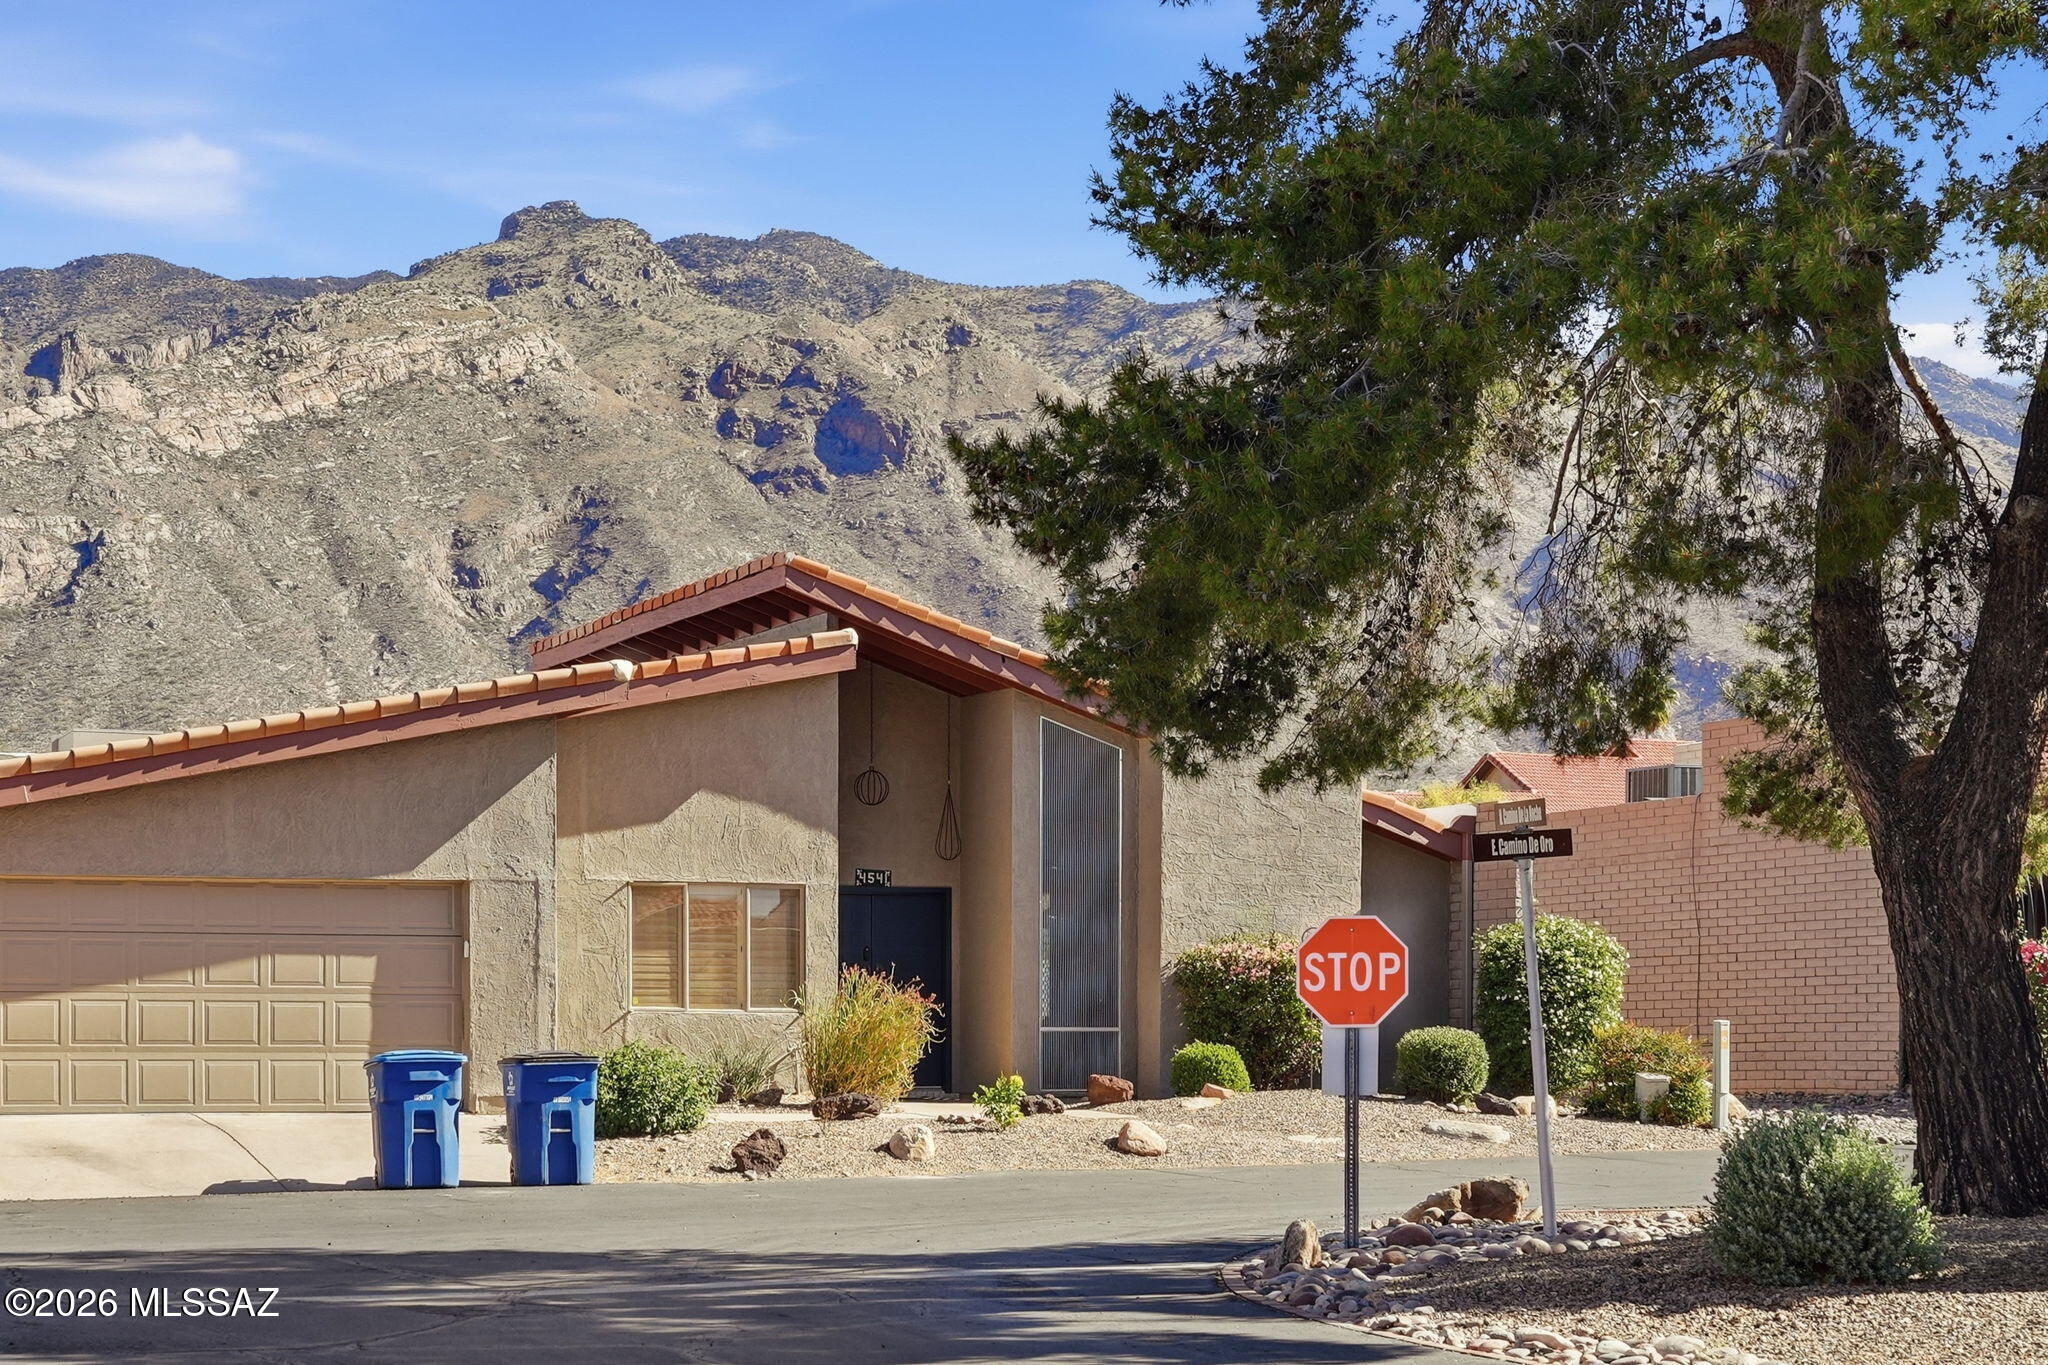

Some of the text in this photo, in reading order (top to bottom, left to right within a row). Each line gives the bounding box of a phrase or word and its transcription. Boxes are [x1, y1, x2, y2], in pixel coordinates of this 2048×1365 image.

[1491, 835, 1553, 856] E. Camino De Oro
[1303, 952, 1401, 992] STOP
